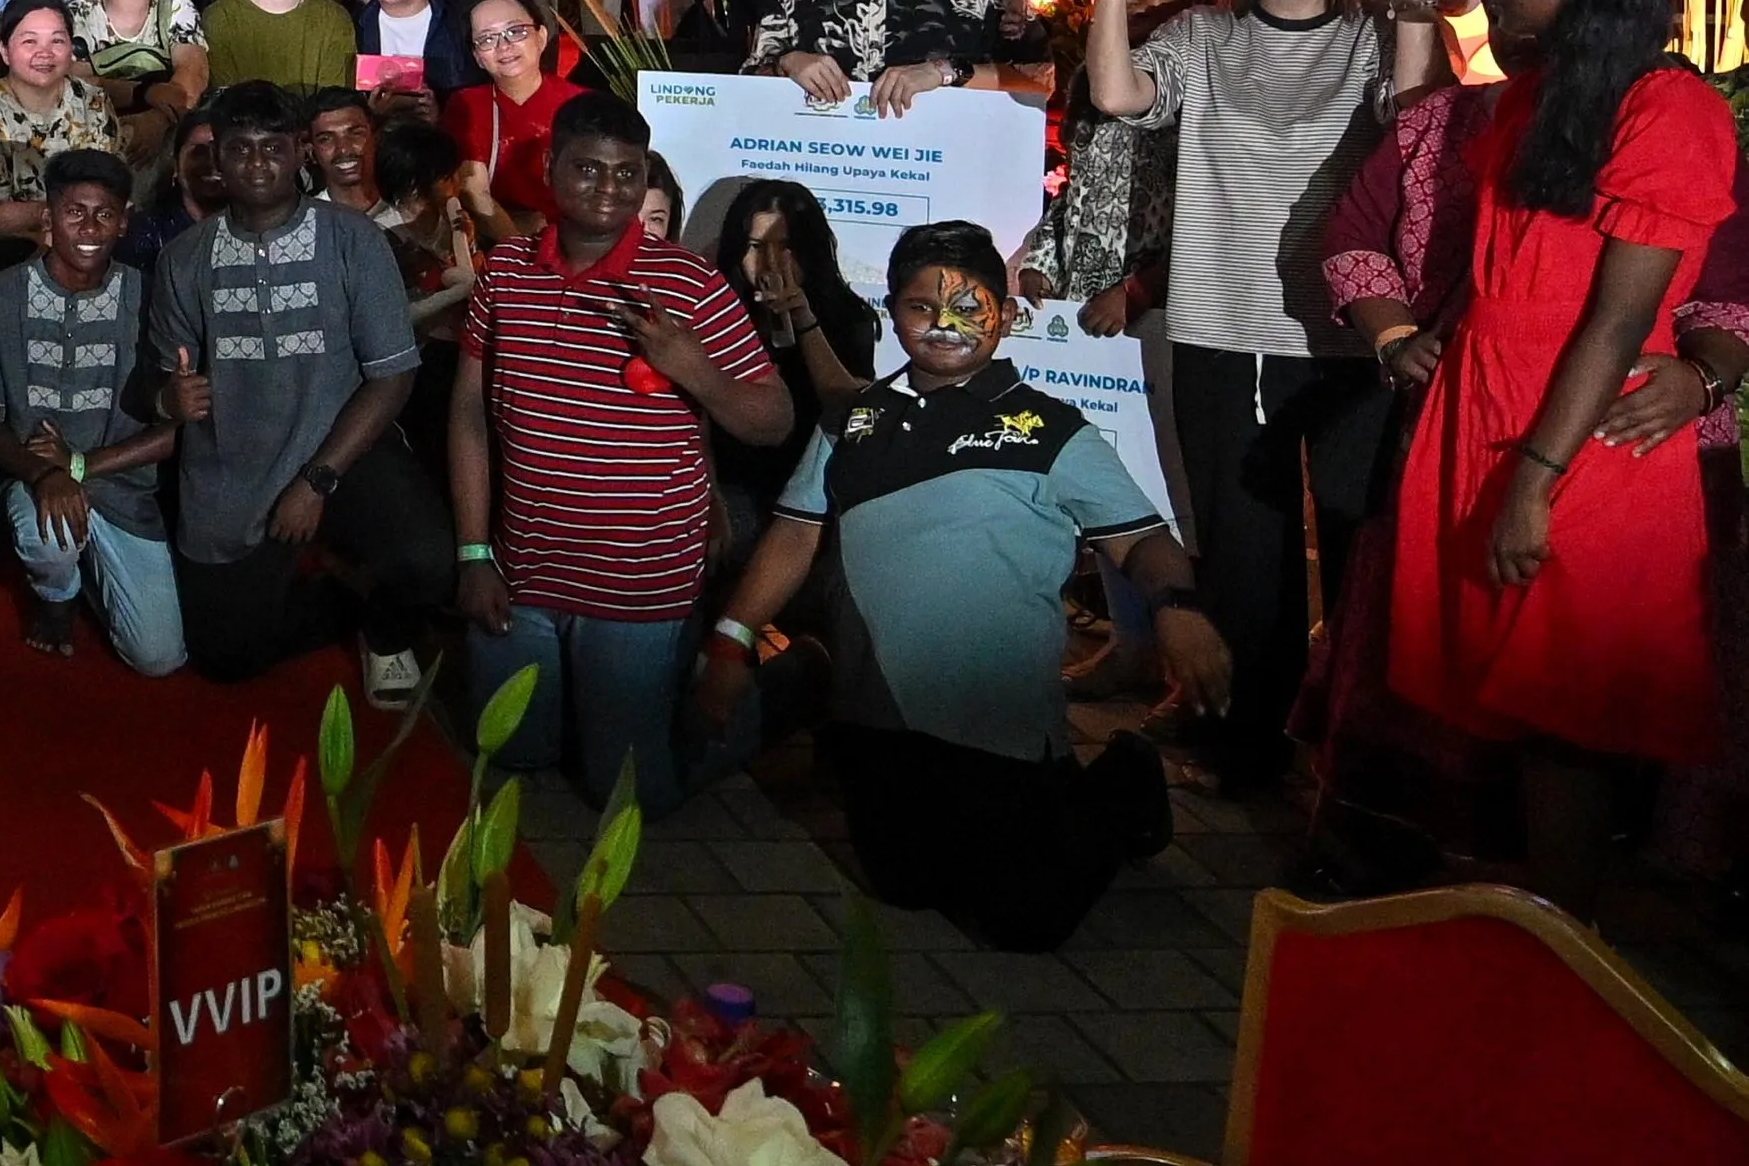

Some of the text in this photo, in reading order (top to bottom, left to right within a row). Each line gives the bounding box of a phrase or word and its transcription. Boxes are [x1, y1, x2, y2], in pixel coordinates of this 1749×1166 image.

[656, 95, 715, 106] PEKERJA
[730, 137, 943, 162] ADRIAN SEOW WEI JIE
[741, 159, 930, 181] Faedah Hilang Upaya Kekal
[1080, 398, 1118, 413] Kekal
[169, 967, 282, 1045] VVIP
